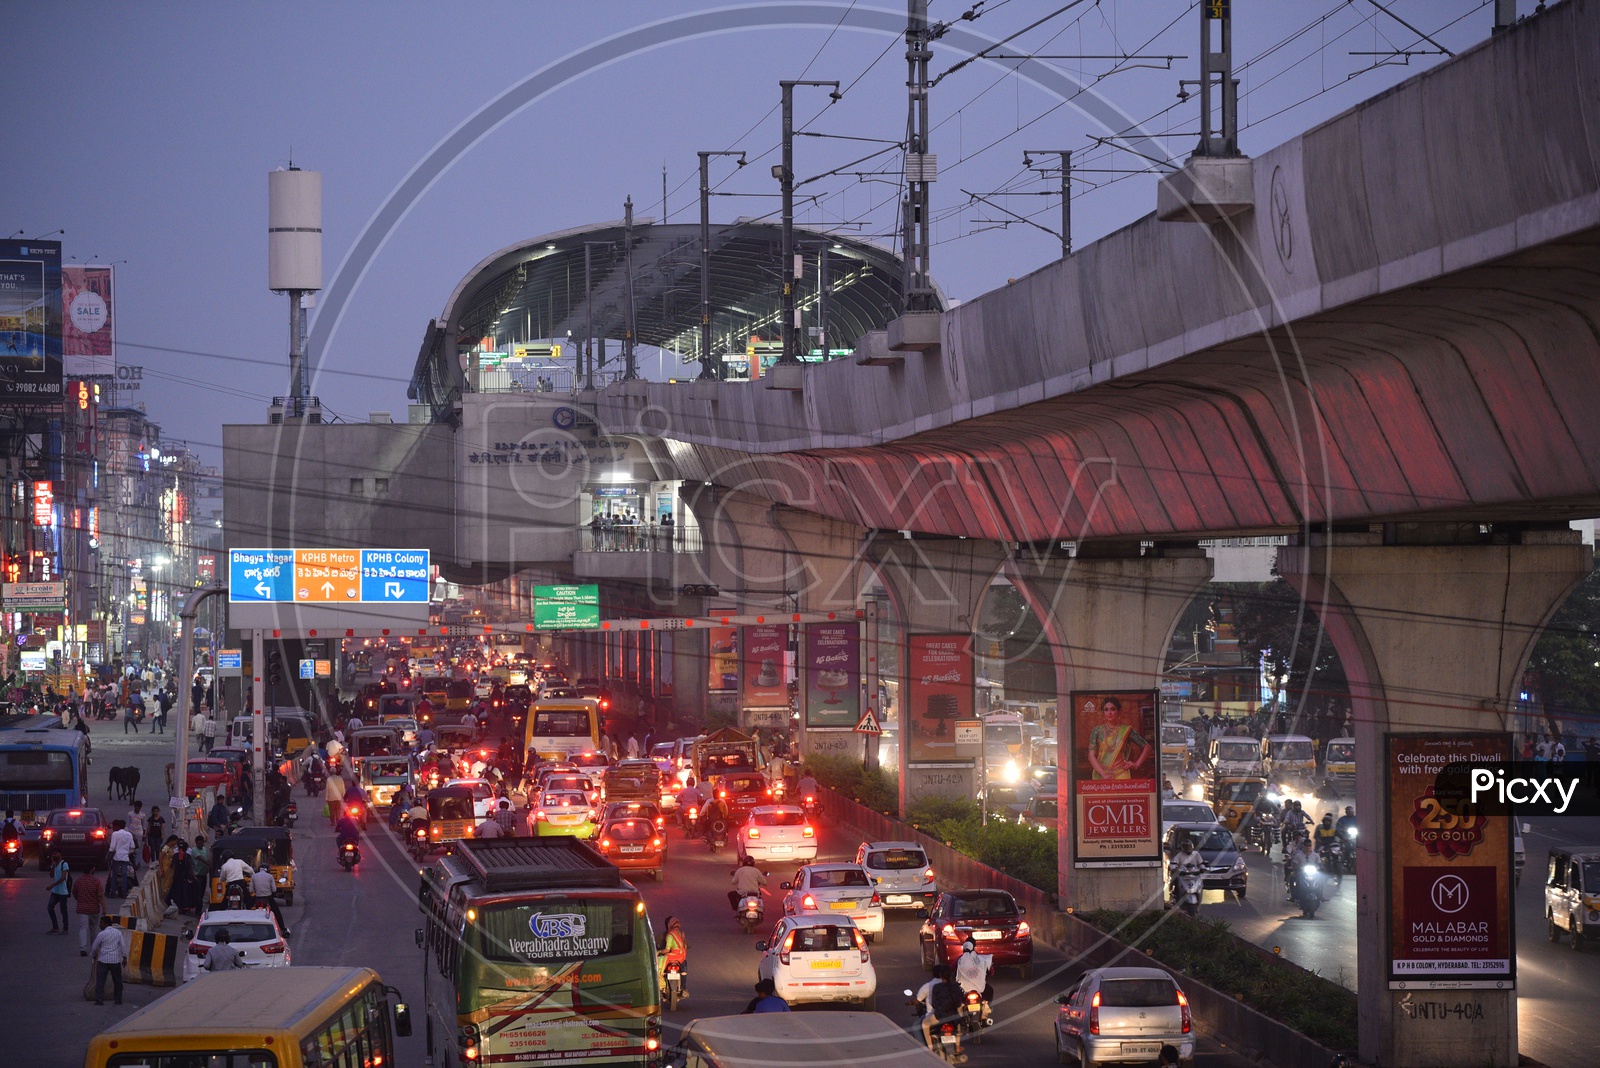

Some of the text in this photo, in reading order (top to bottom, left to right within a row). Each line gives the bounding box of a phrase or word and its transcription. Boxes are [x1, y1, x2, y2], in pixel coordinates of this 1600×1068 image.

[1212, 8, 1222, 18] 31
[15, 383, 60, 392] 99082 44800
[233, 553, 292, 565] Bhagya Nagar
[302, 553, 355, 563] KPHB Metro
[367, 553, 424, 565] KPHB Colony
[1397, 753, 1501, 763] Celebrate this Diwali
[1400, 765, 1421, 774] with
[1424, 765, 1444, 774] free
[1088, 804, 1146, 825] CMR
[1420, 798, 1477, 830] 250
[1088, 825, 1147, 835] JEWELLERS
[1420, 830, 1475, 841] KG GOLD
[529, 912, 572, 938] VBS
[1412, 922, 1488, 933] MALABAR
[510, 936, 609, 953] Veerabhadra Swamy
